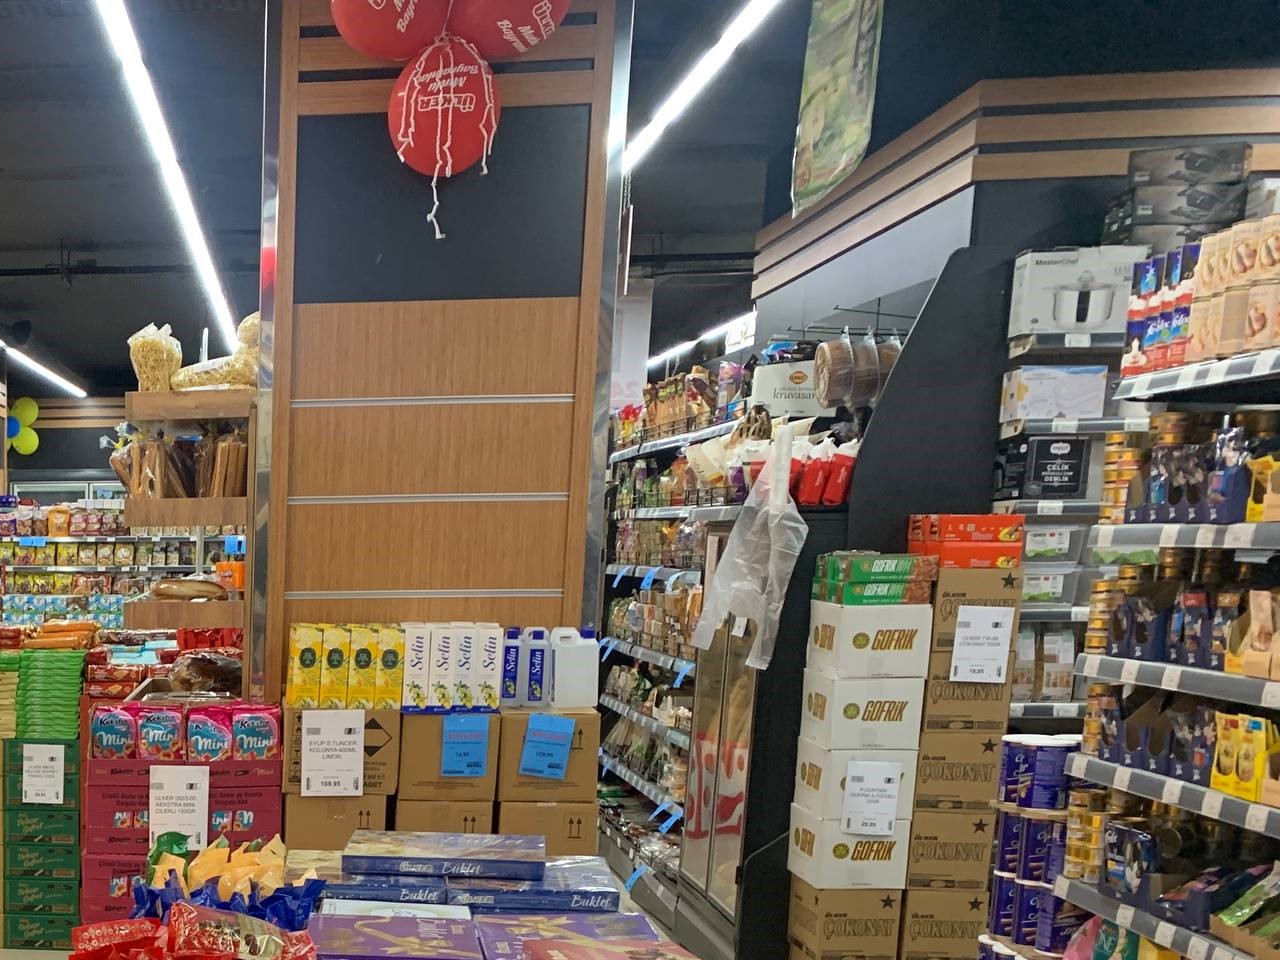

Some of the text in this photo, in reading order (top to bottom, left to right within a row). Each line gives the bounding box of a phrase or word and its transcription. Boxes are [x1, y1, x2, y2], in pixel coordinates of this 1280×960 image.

[410, 634, 425, 671] Selin
[436, 635, 451, 671] Selin
[459, 634, 474, 671] Selin
[483, 634, 498, 672] Selin
[505, 648, 518, 674] Selin
[532, 650, 543, 676] Selin
[919, 762, 996, 783] ÇOKONAT
[912, 842, 986, 864] ÇOKONAT
[442, 861, 481, 876] Buklet
[399, 888, 439, 902] Buklet
[571, 894, 611, 908] Buklet
[824, 918, 896, 941] ÇOKONAT
